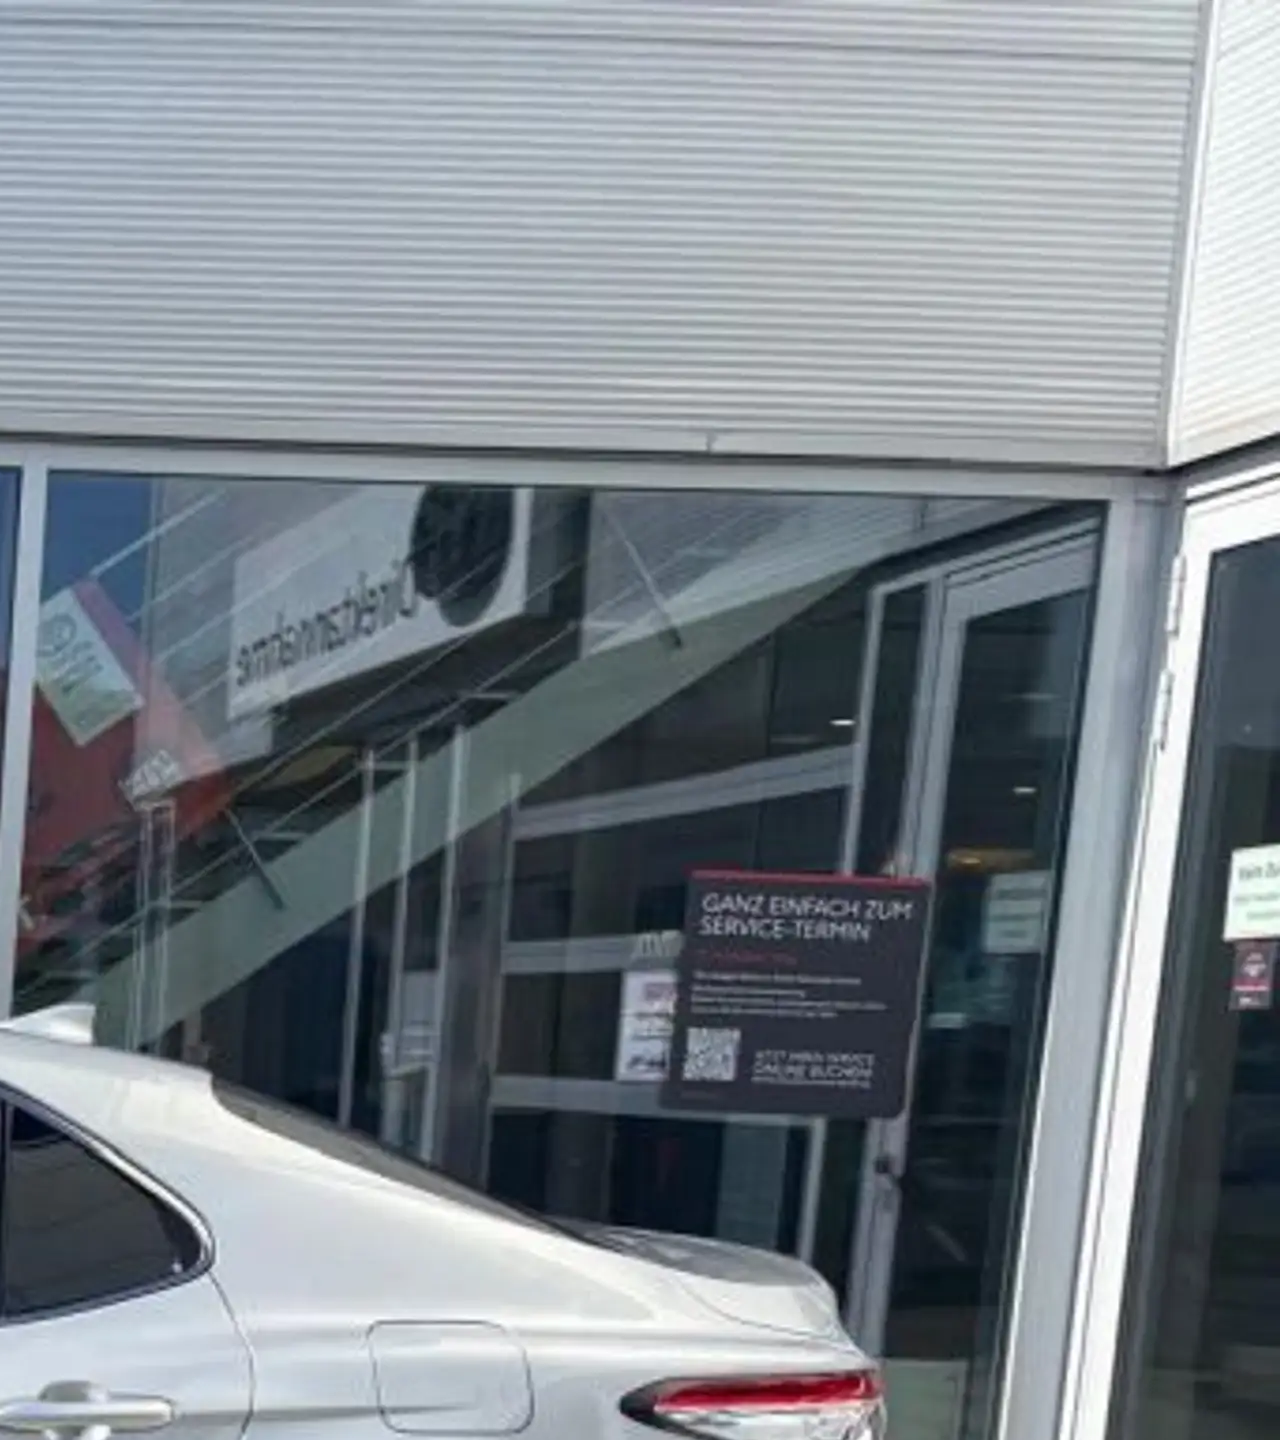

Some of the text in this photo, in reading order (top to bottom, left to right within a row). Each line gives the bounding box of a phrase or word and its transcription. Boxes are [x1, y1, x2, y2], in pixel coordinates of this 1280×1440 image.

[701, 892, 914, 921] GANZ EINFACH ZUM
